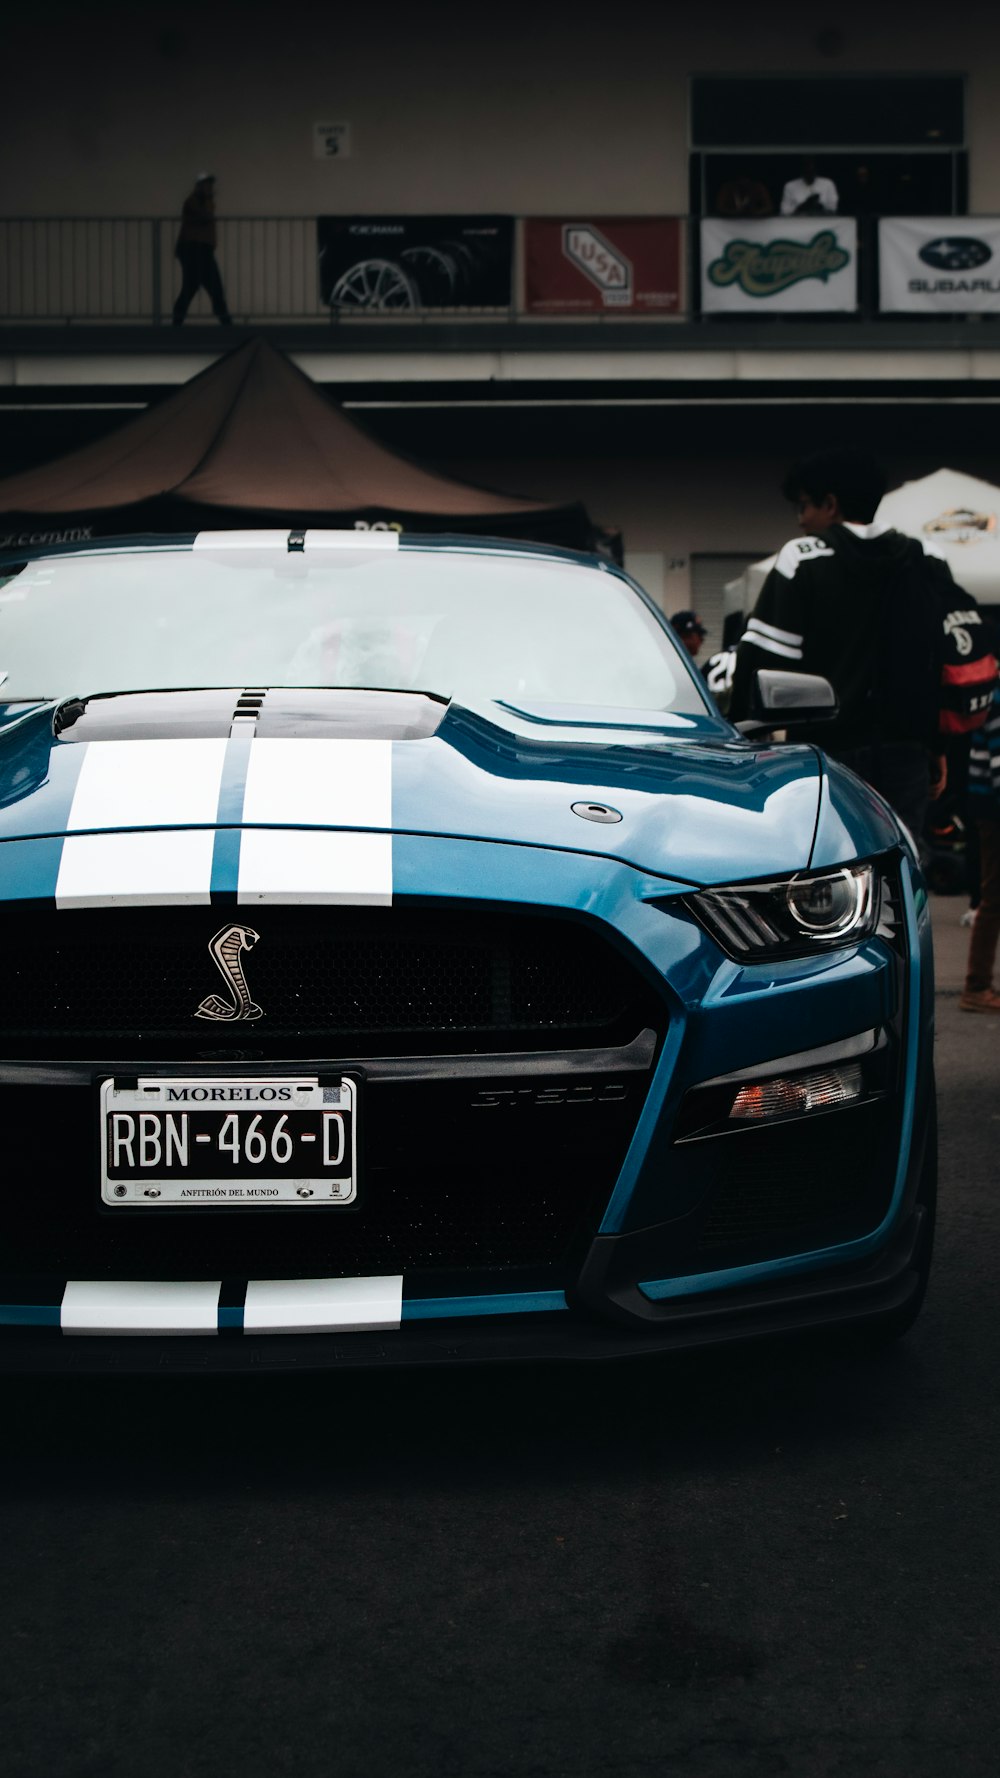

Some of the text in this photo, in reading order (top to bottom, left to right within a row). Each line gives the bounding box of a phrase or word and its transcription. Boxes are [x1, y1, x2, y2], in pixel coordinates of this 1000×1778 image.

[326, 137, 339, 156] 5
[572, 234, 622, 283] IUSA
[167, 1087, 292, 1101] MORELOS
[113, 1113, 345, 1167] RBN-466-D
[180, 1187, 279, 1197] ANFITRIÓN DEL MUNDO
